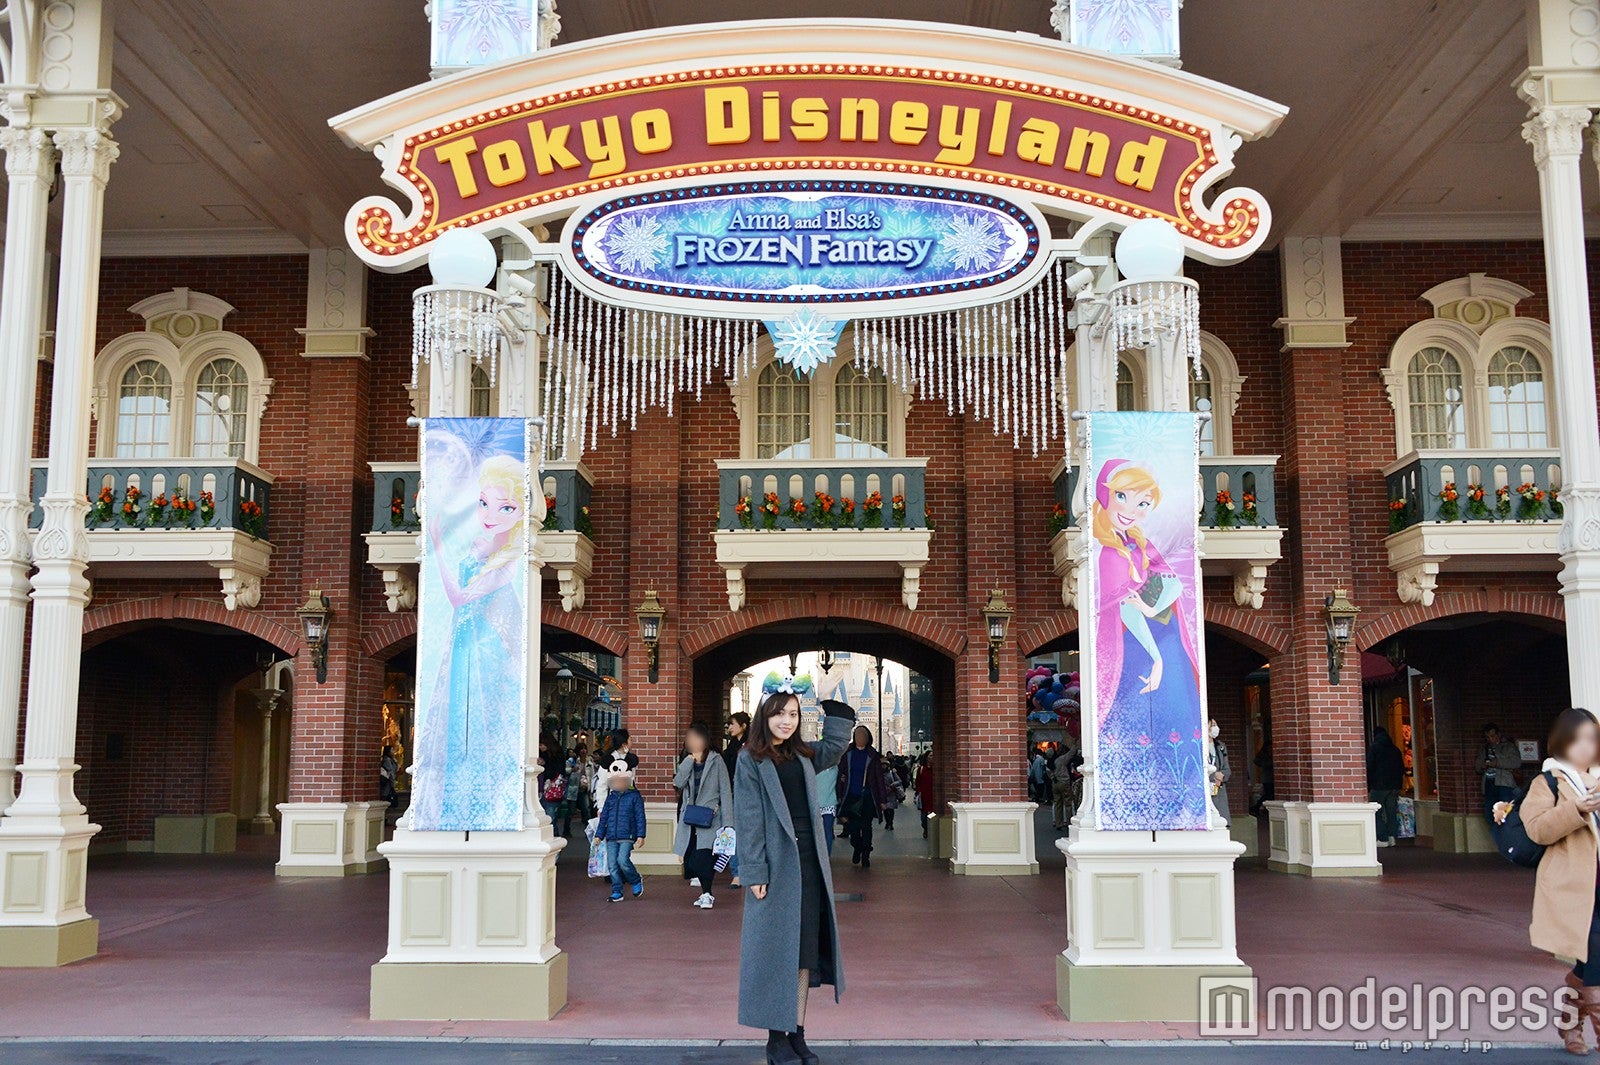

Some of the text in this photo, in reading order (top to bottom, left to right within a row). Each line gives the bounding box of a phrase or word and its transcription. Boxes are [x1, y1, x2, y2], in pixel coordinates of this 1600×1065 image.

[434, 86, 1167, 199] Tokyo Disneyland
[728, 208, 882, 231] Anna and Elsa's
[675, 234, 933, 269] FROZEN Fantasy
